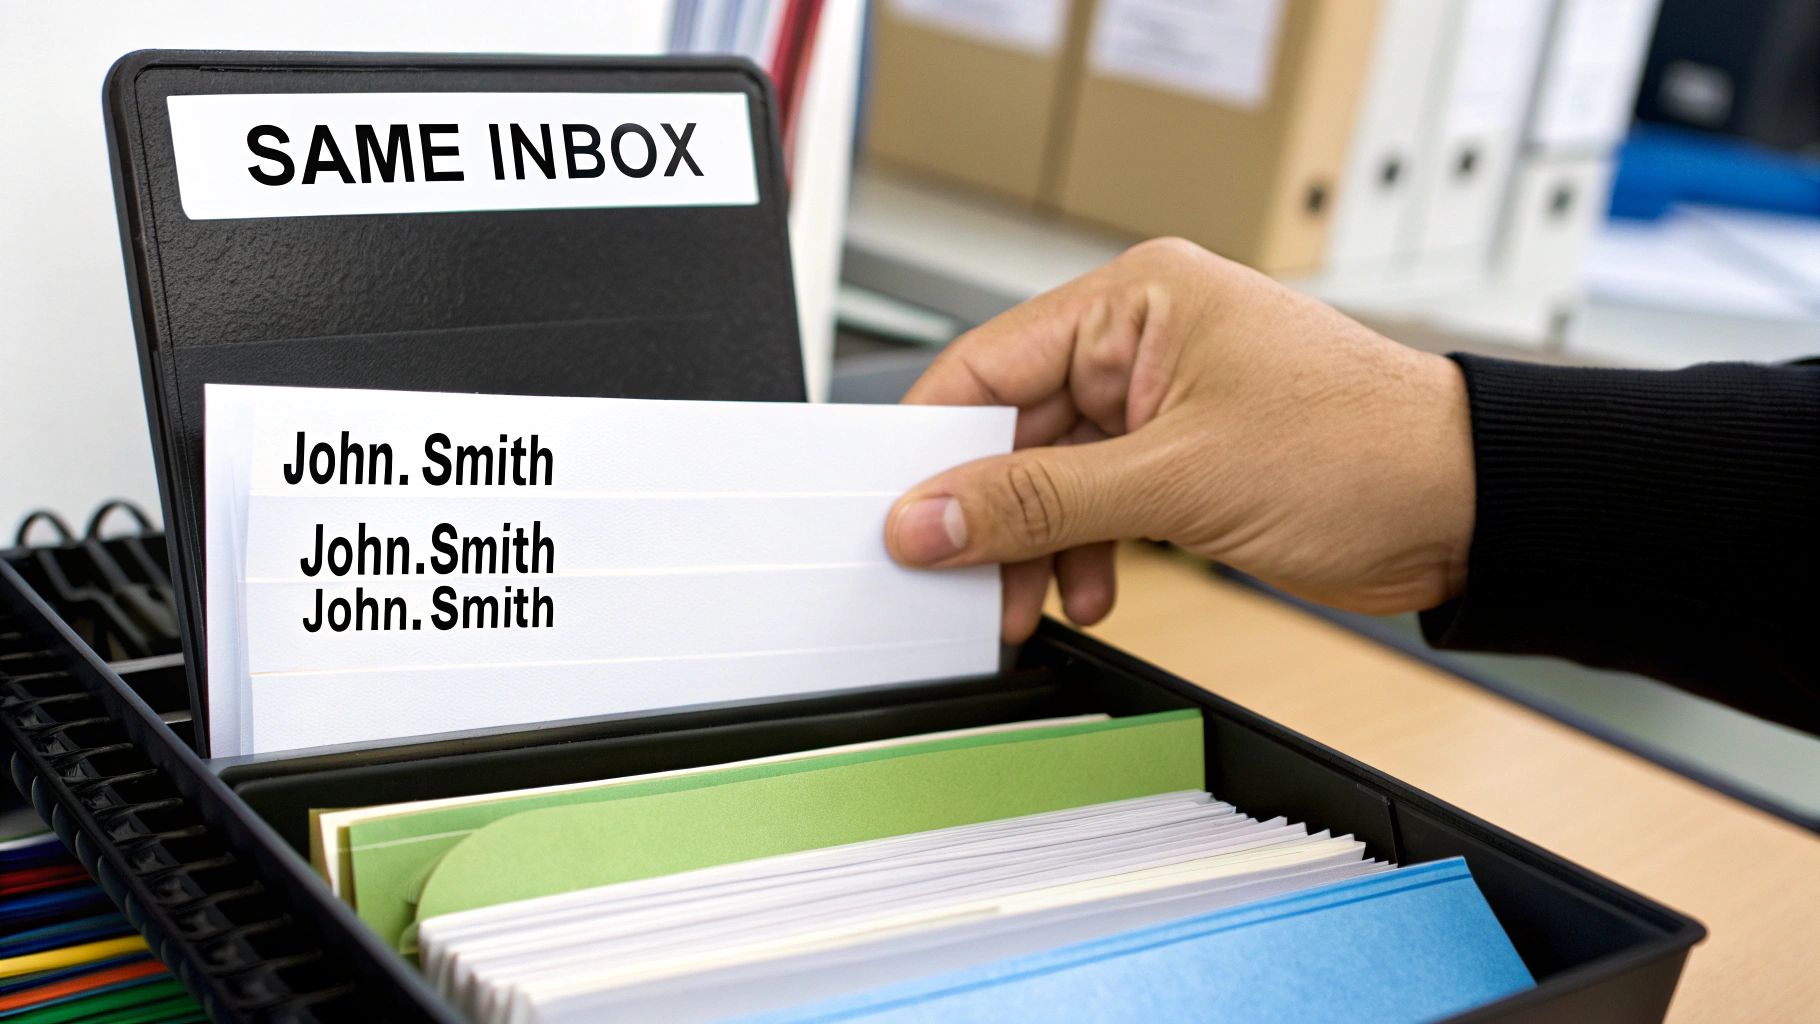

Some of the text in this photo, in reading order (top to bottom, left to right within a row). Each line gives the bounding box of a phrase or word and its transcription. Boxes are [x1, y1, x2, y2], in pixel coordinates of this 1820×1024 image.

[246, 122, 706, 187] SAME INBOX
[283, 430, 554, 487] John. Smith
